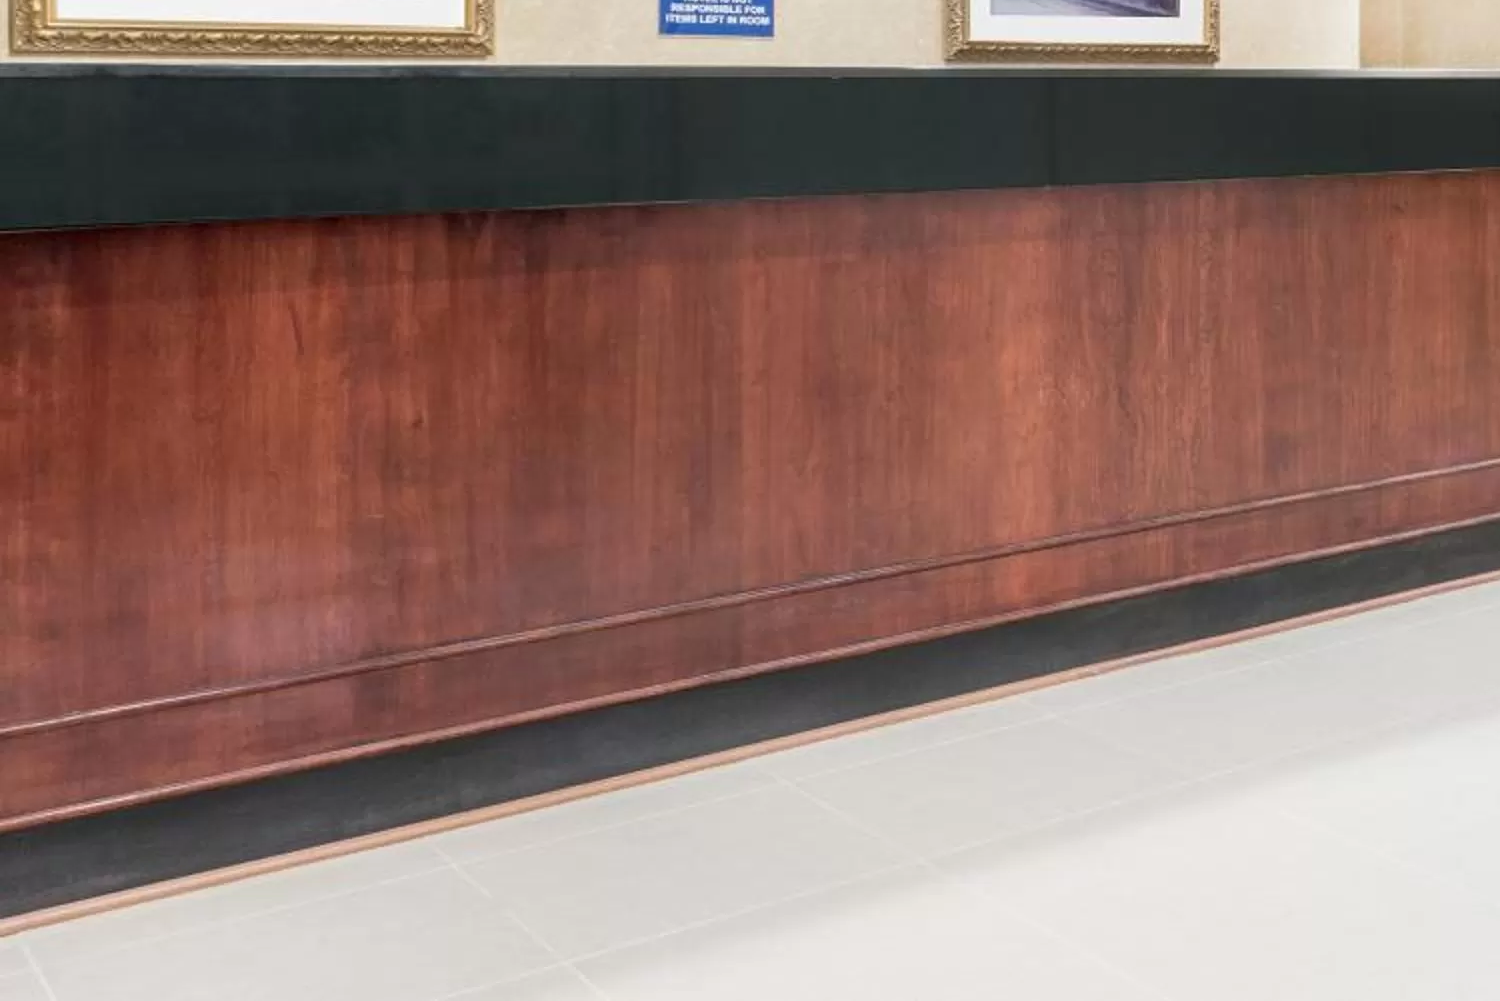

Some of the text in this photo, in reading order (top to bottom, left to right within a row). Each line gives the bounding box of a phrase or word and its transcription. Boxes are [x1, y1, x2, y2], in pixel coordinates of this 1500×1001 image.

[670, 3, 766, 15] RESPONSIBLE FOR
[665, 14, 771, 26] ITEMS LEFT IN ROOM
